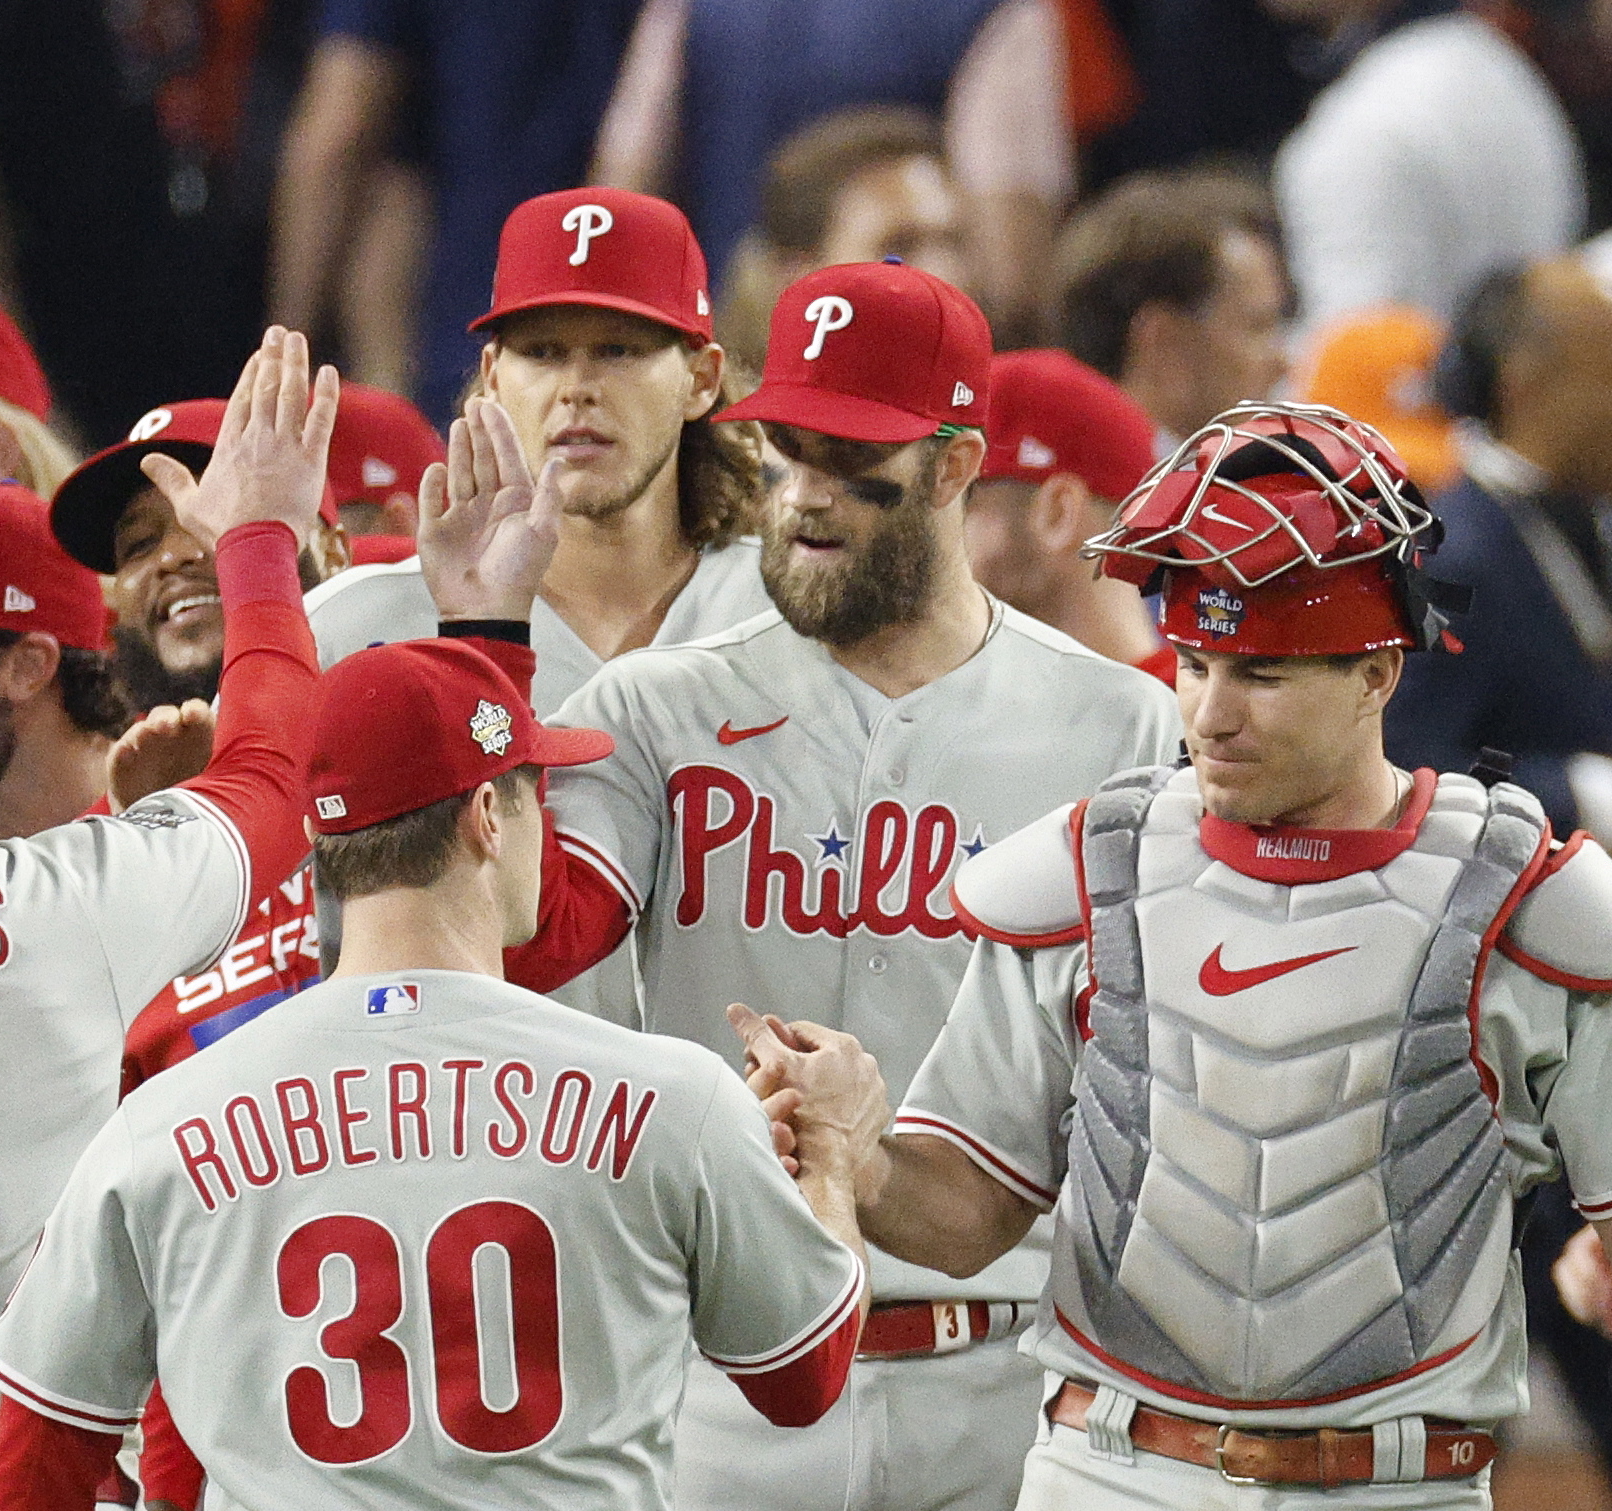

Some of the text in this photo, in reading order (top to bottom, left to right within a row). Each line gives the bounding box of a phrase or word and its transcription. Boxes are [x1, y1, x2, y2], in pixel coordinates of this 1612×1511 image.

[562, 204, 613, 266] P
[804, 295, 854, 360] P
[1199, 591, 1243, 612] WORLD
[1198, 616, 1237, 635] SERIES
[470, 707, 507, 732] WORLD
[482, 730, 513, 755] SERIES
[1256, 836, 1331, 862] REALMUTO
[171, 1057, 659, 1214] ROBERTSON
[274, 1197, 567, 1470] 30
[945, 1304, 959, 1338] 3
[1447, 1441, 1475, 1467] 10
